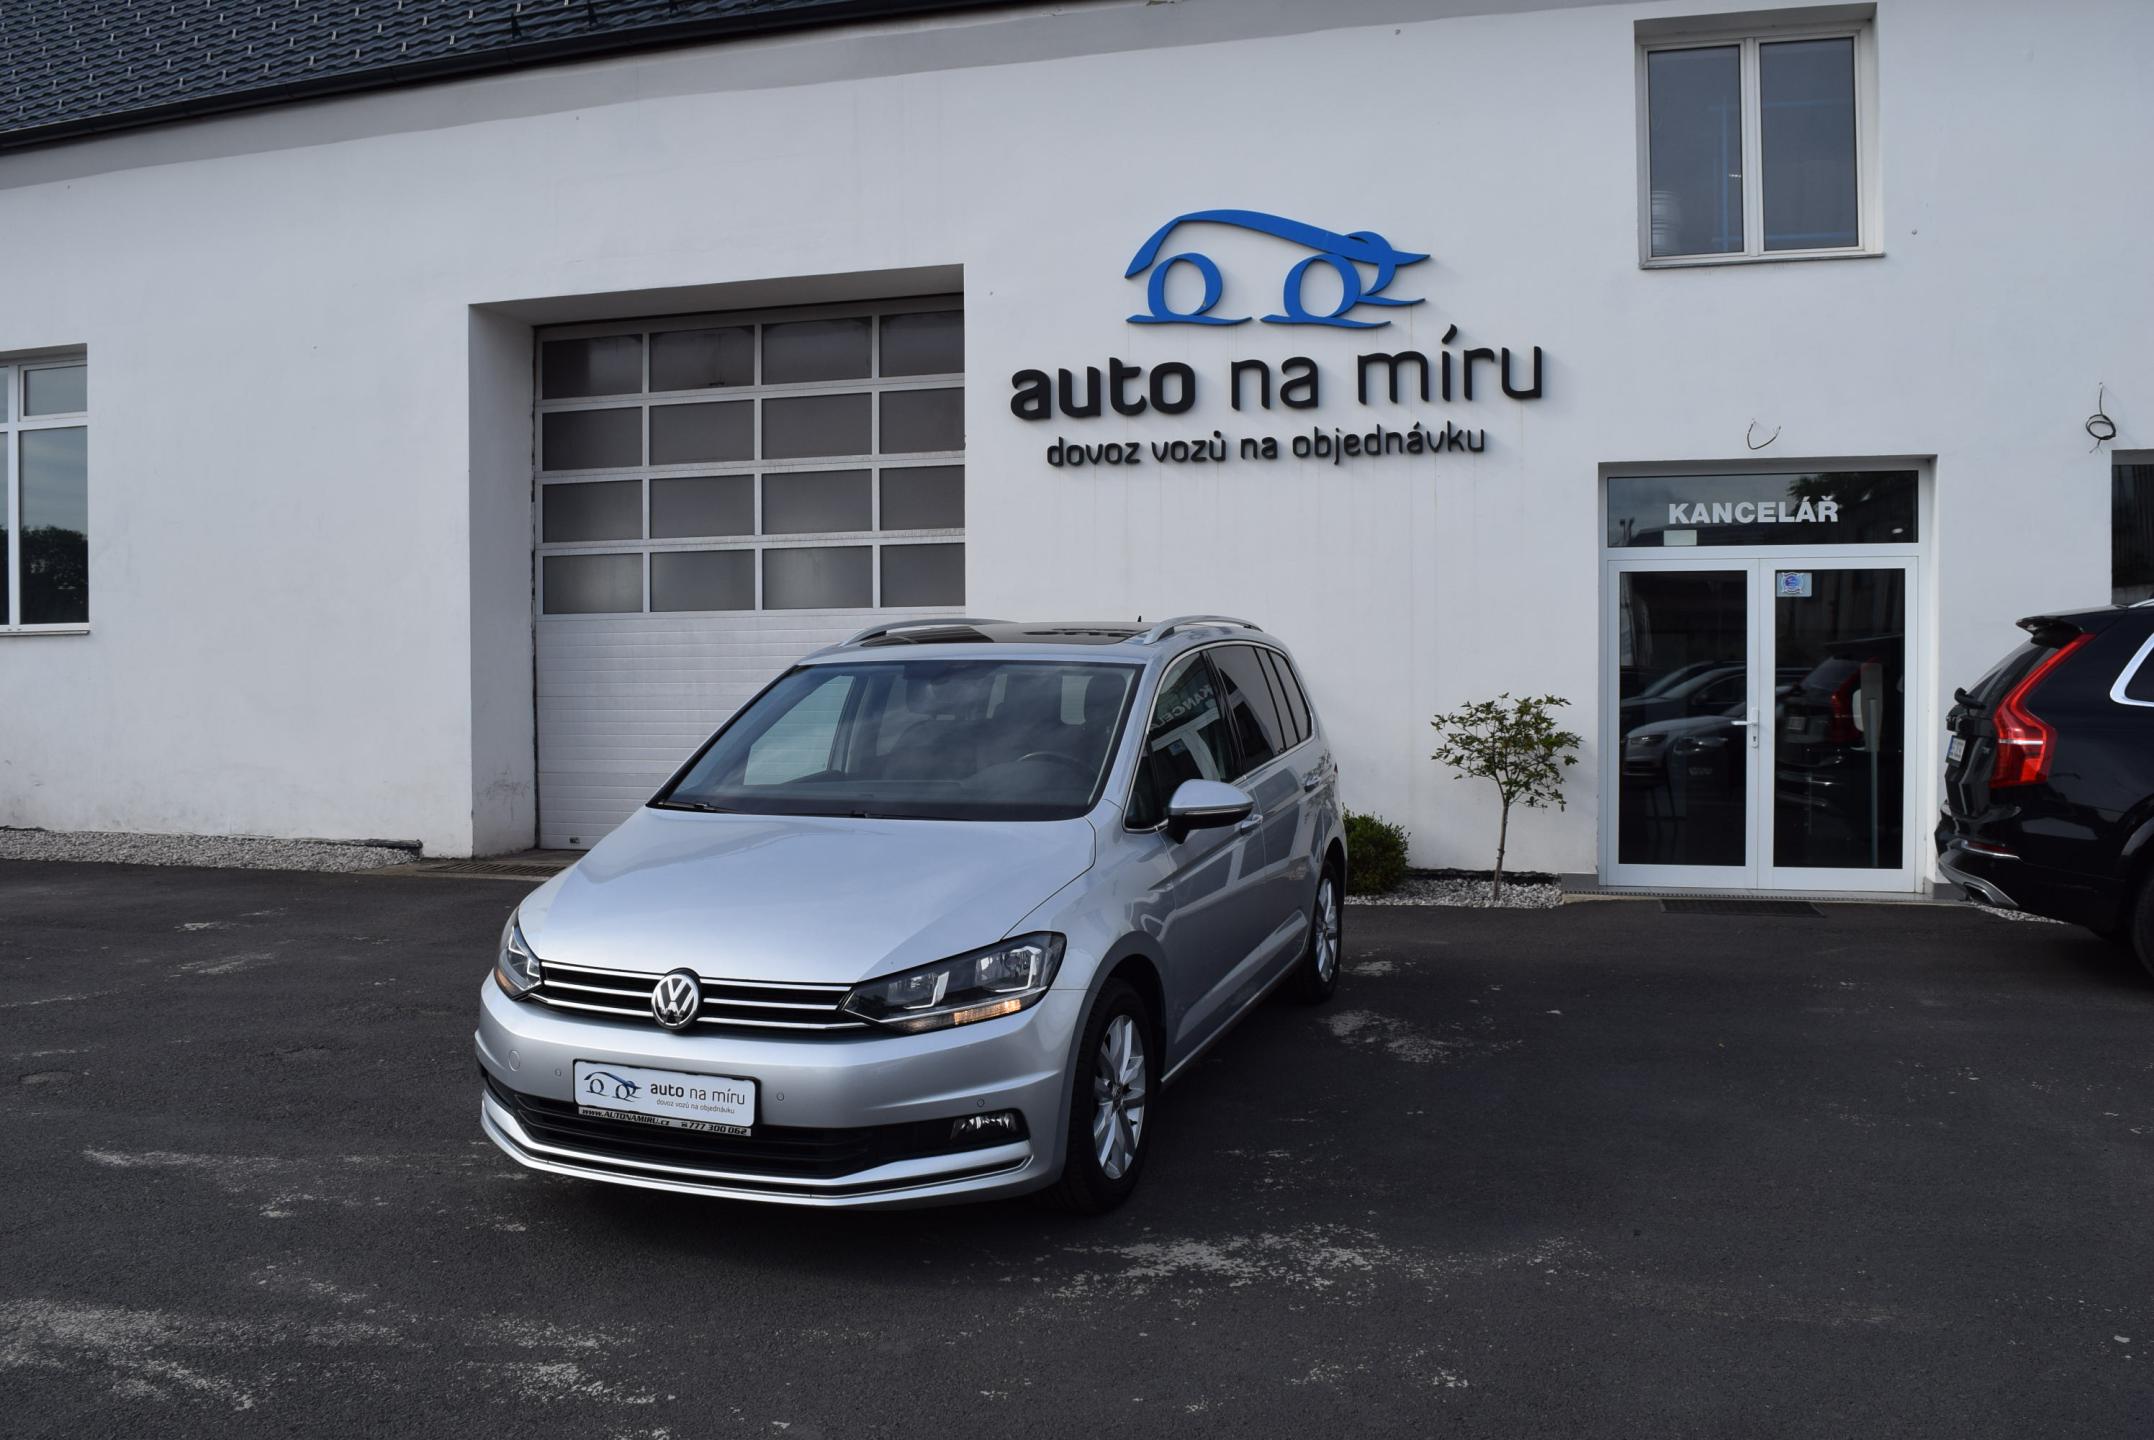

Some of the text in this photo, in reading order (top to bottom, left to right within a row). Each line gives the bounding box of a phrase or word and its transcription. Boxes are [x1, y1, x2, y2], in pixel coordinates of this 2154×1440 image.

[1010, 324, 1543, 420] auto na míru
[1047, 421, 1486, 467] dovoz vozů na objednávku
[1668, 496, 1839, 525] KANCELÁŘ
[652, 974, 698, 1026] VW
[650, 1083, 745, 1105] auto na míru
[656, 1098, 674, 1108] dovoz
[689, 1122, 706, 1130] 777
[708, 1124, 726, 1133] 300
[727, 1127, 747, 1136] 062
